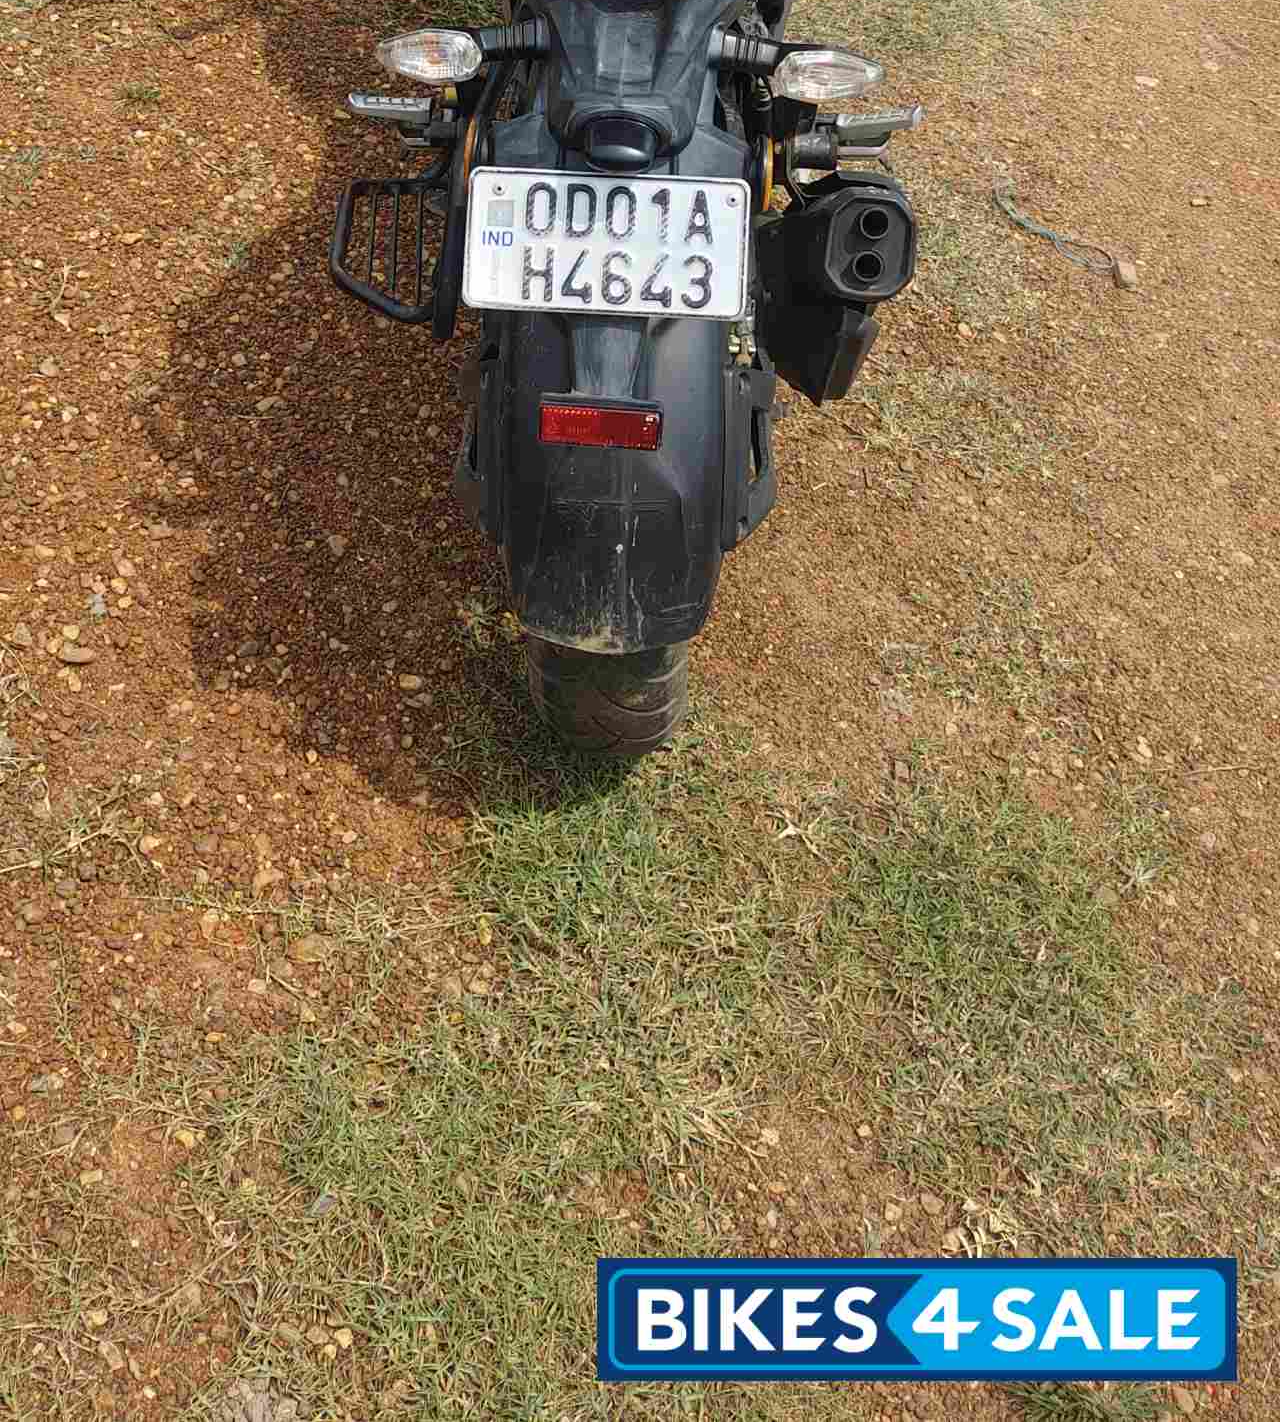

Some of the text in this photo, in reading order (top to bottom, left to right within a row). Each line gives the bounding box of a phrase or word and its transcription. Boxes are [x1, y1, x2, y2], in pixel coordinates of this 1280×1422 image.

[482, 231, 513, 247] IND
[525, 181, 713, 245] OD01A
[521, 246, 713, 308] H4643
